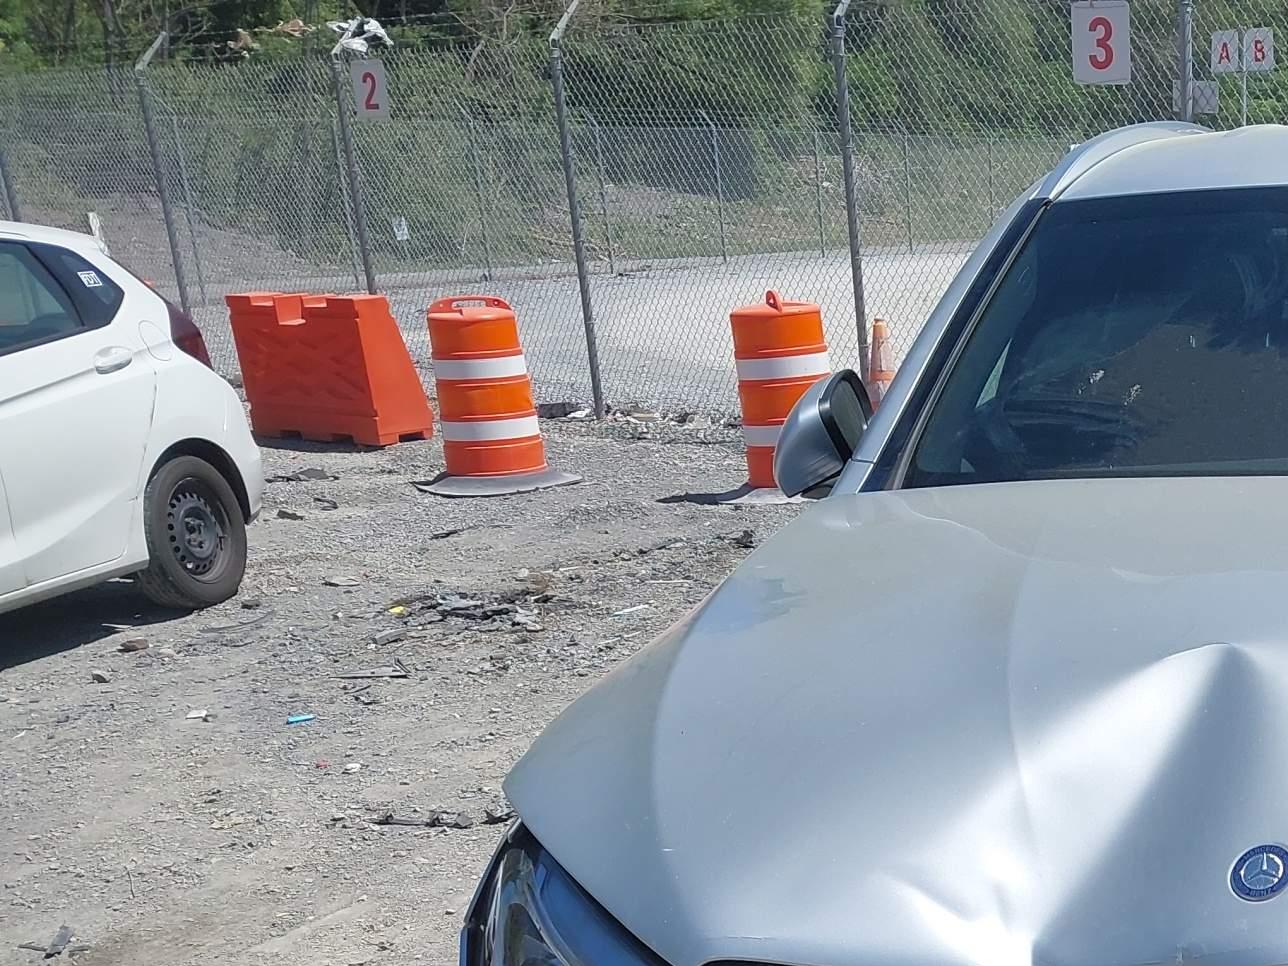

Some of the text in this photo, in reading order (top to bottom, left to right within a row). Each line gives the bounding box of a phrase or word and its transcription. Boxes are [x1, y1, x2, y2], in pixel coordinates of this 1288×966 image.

[1088, 16, 1114, 70] 3
[1218, 42, 1232, 65] A
[1254, 39, 1266, 63] B
[362, 71, 380, 111] 2
